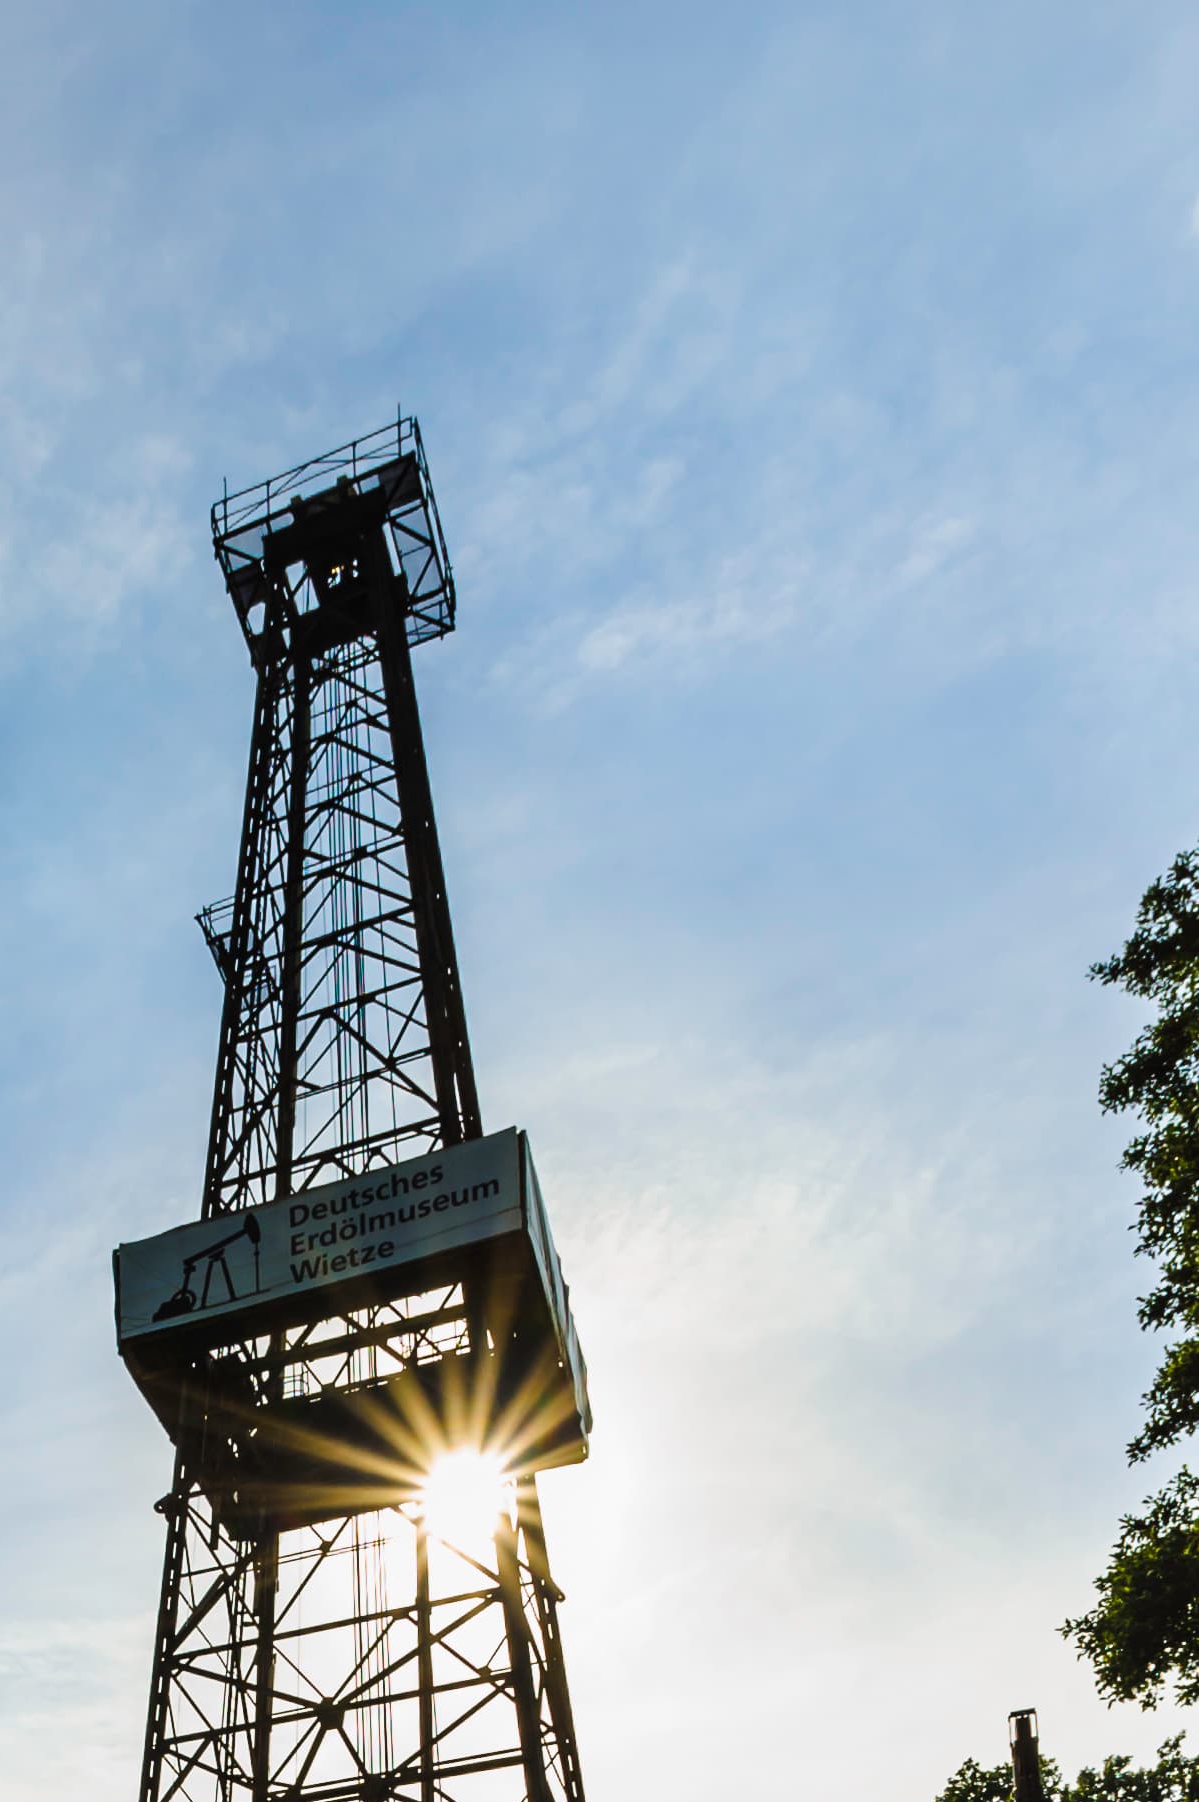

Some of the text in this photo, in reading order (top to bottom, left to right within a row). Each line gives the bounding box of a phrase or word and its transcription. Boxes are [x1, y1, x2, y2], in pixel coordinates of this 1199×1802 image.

[289, 1164, 444, 1228] Deutsches
[290, 1177, 500, 1256] Erdölmuseum
[289, 1239, 396, 1284] Wietze
